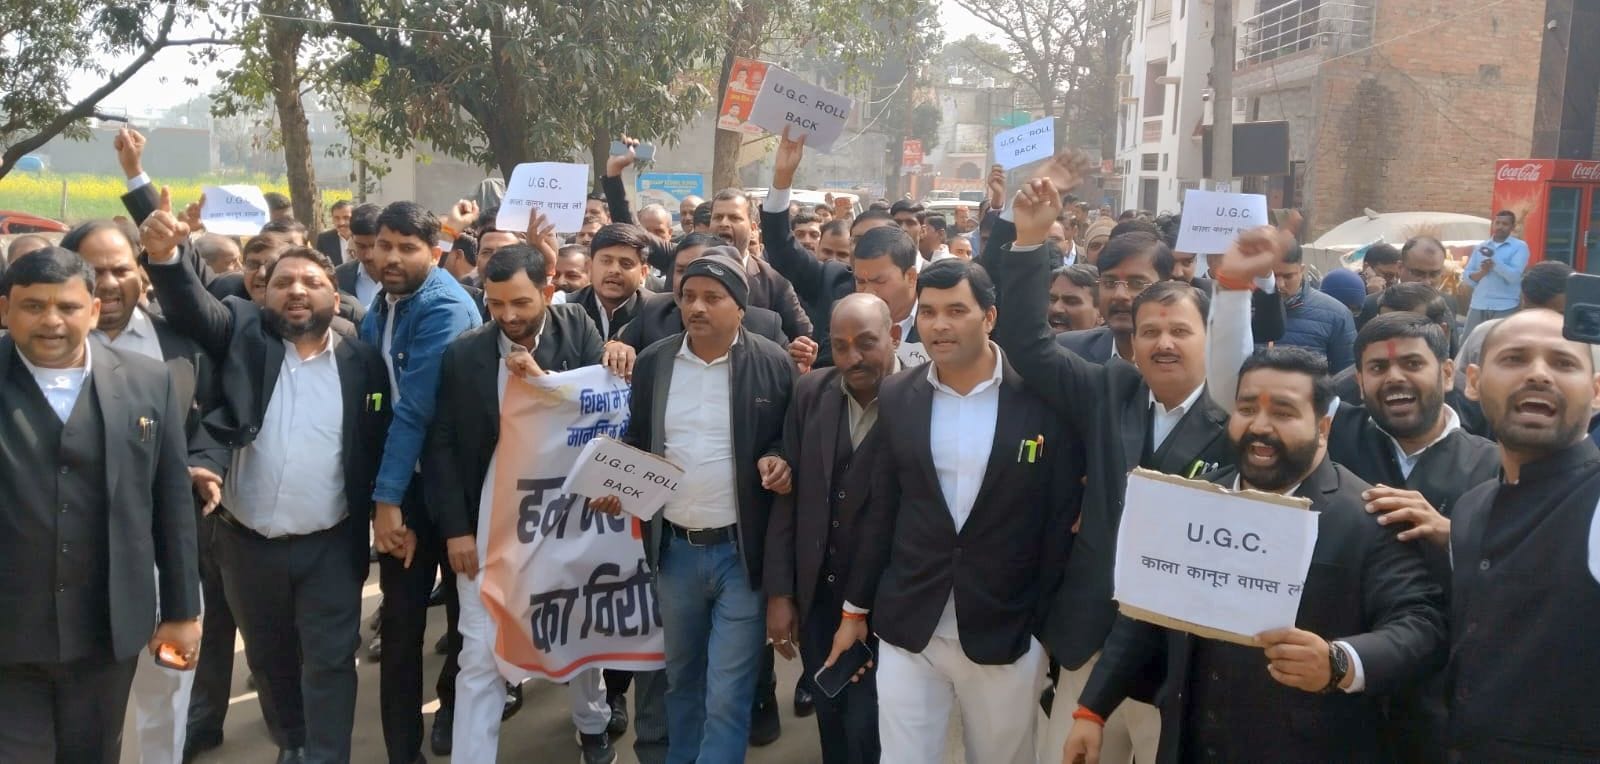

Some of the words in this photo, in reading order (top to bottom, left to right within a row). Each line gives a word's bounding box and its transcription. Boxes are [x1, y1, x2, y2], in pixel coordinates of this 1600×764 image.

[773, 83, 808, 106] U.G.C.
[815, 100, 845, 120] ROLL
[785, 111, 818, 131] BACK
[1030, 126, 1050, 136] ROLL
[1015, 144, 1038, 156] BACK
[528, 177, 562, 190] U.G.C.
[1217, 207, 1253, 218] U.G.C.
[580, 388, 611, 416] शिक्षा
[595, 453, 636, 475] U.G.C.
[643, 471, 679, 491] ROLL
[603, 478, 644, 499] BACK
[1187, 522, 1267, 554] U.G.C.
[1141, 555, 1180, 575] काला
[1187, 565, 1231, 588] कानून
[1238, 574, 1280, 594] वापस
[530, 586, 579, 653] का
